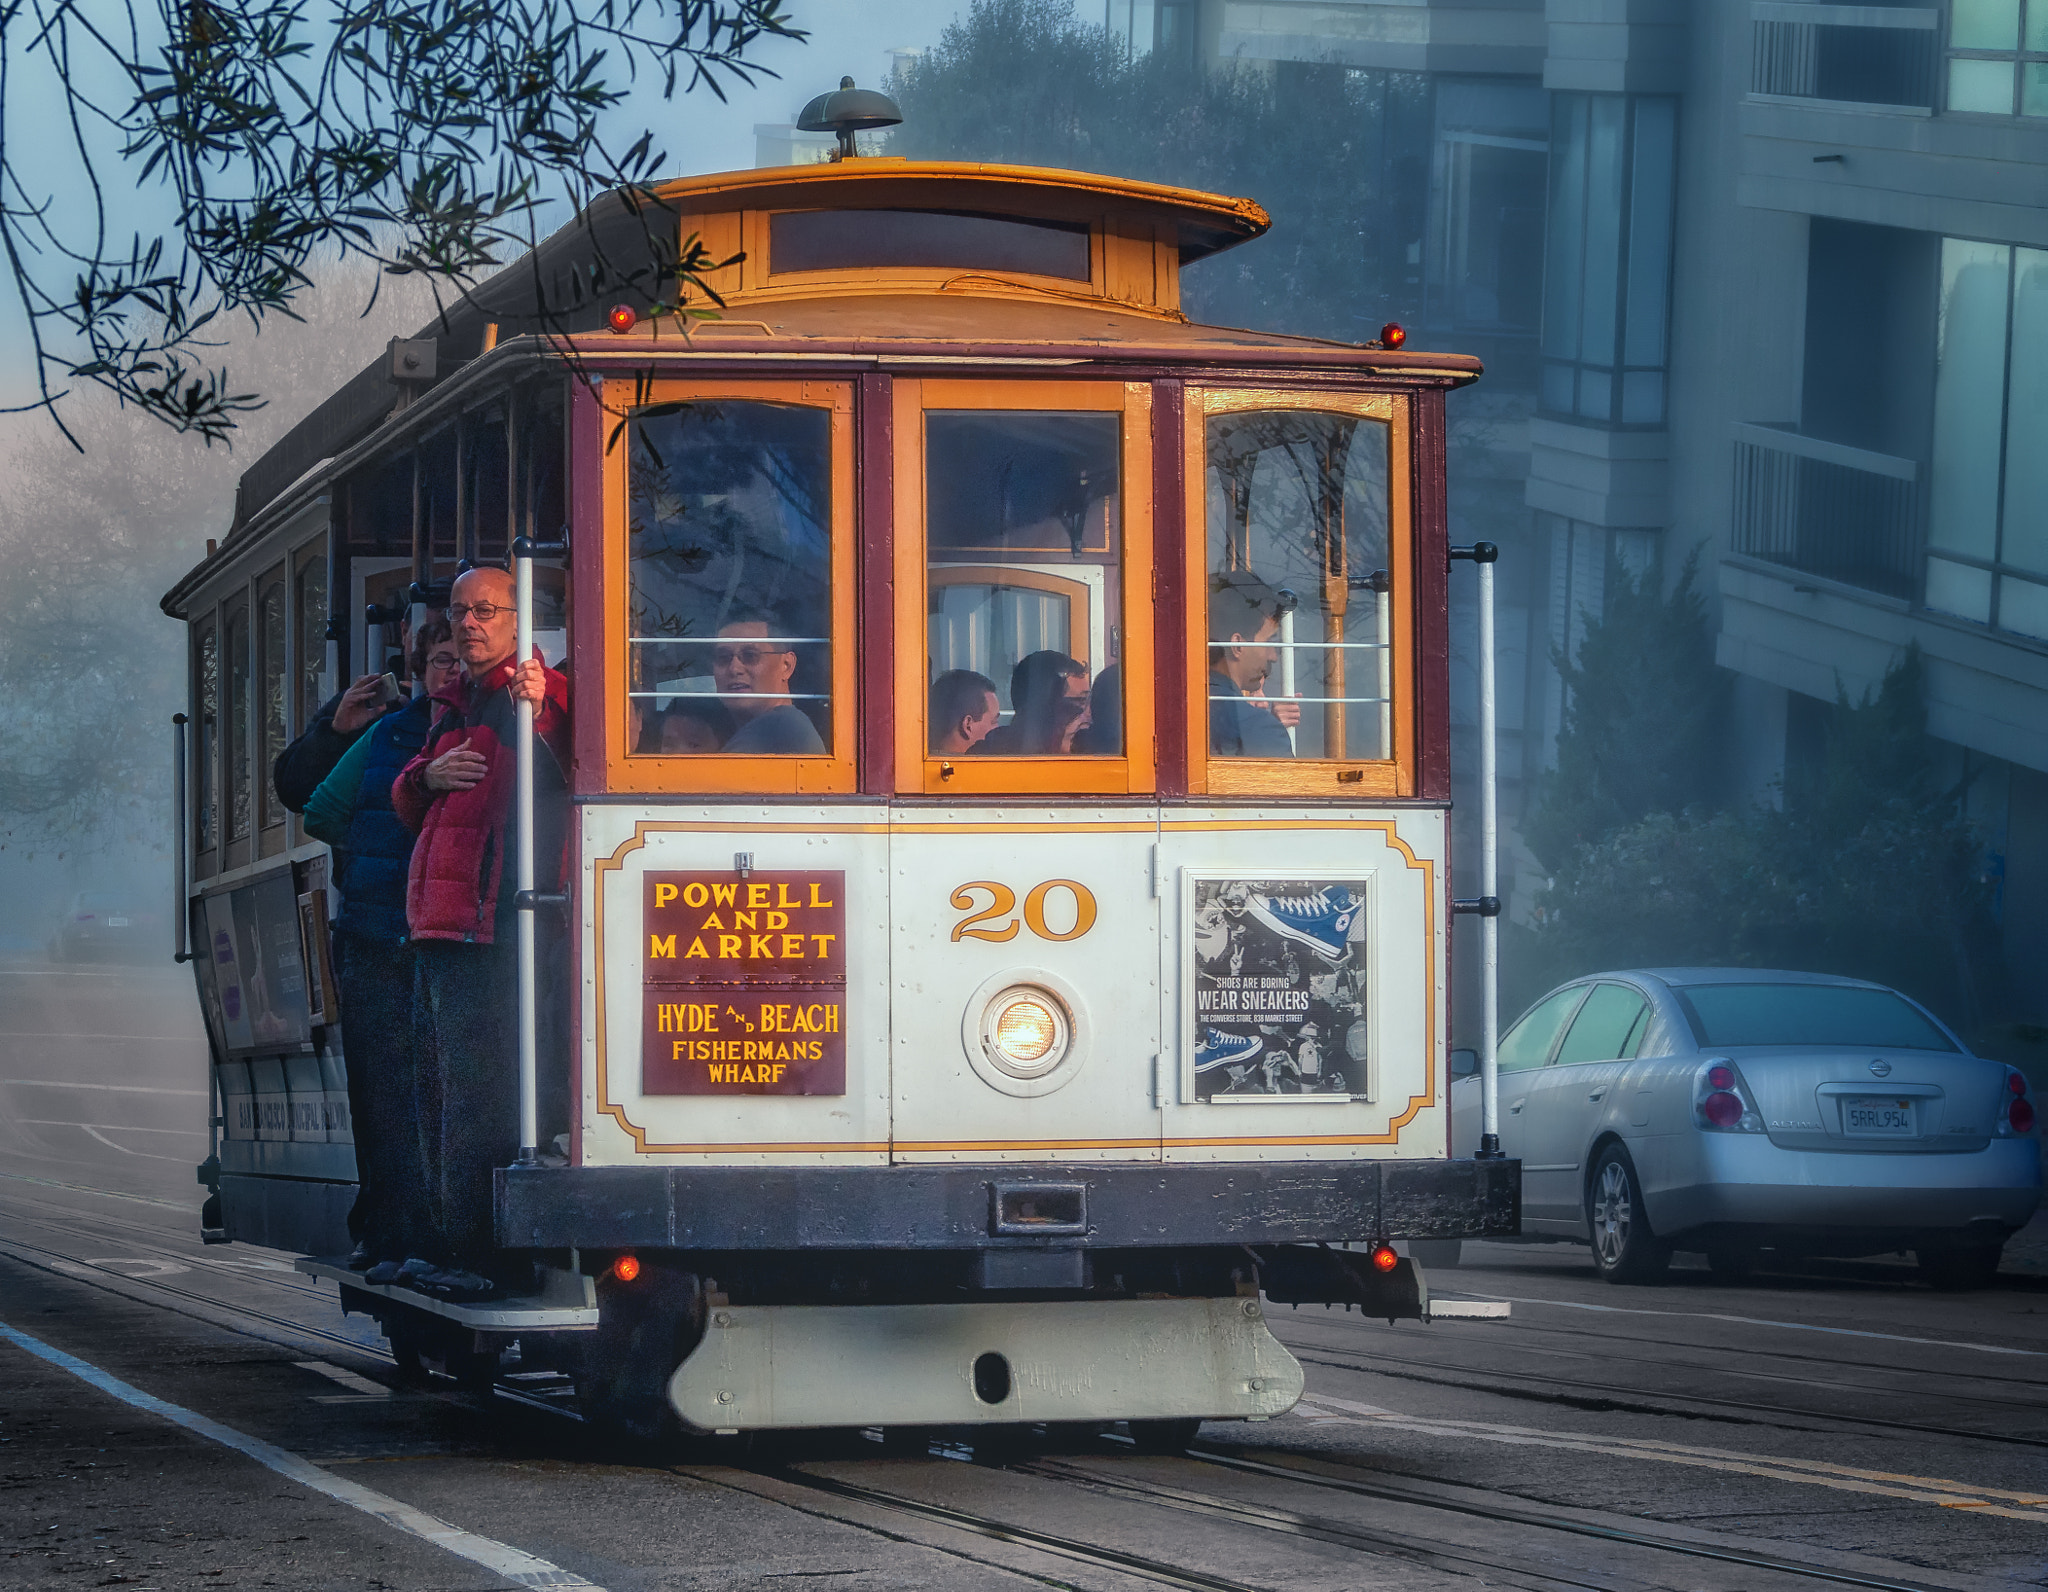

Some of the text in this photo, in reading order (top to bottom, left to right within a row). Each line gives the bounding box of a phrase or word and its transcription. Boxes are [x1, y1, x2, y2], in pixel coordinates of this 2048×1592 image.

[654, 882, 833, 908] POWELL
[700, 911, 789, 930] AND
[949, 878, 1098, 943] 20
[650, 934, 836, 959] MARKET
[1216, 977, 1290, 989] SHOES ARE BORING
[1197, 990, 1309, 1010] WEAR SNEAKERS
[657, 1004, 839, 1033] HYDE AND BEACH
[1200, 1014, 1209, 1023] THE
[1210, 1014, 1236, 1023] CONVERSE
[1265, 1014, 1285, 1023] MARKET
[1285, 1014, 1303, 1023] STREET
[672, 1041, 823, 1061] FISHERMANS
[708, 1063, 787, 1083] WHARF
[1769, 1120, 1822, 1129] ALTIMA
[1851, 1110, 1909, 1129] 5RRL954
